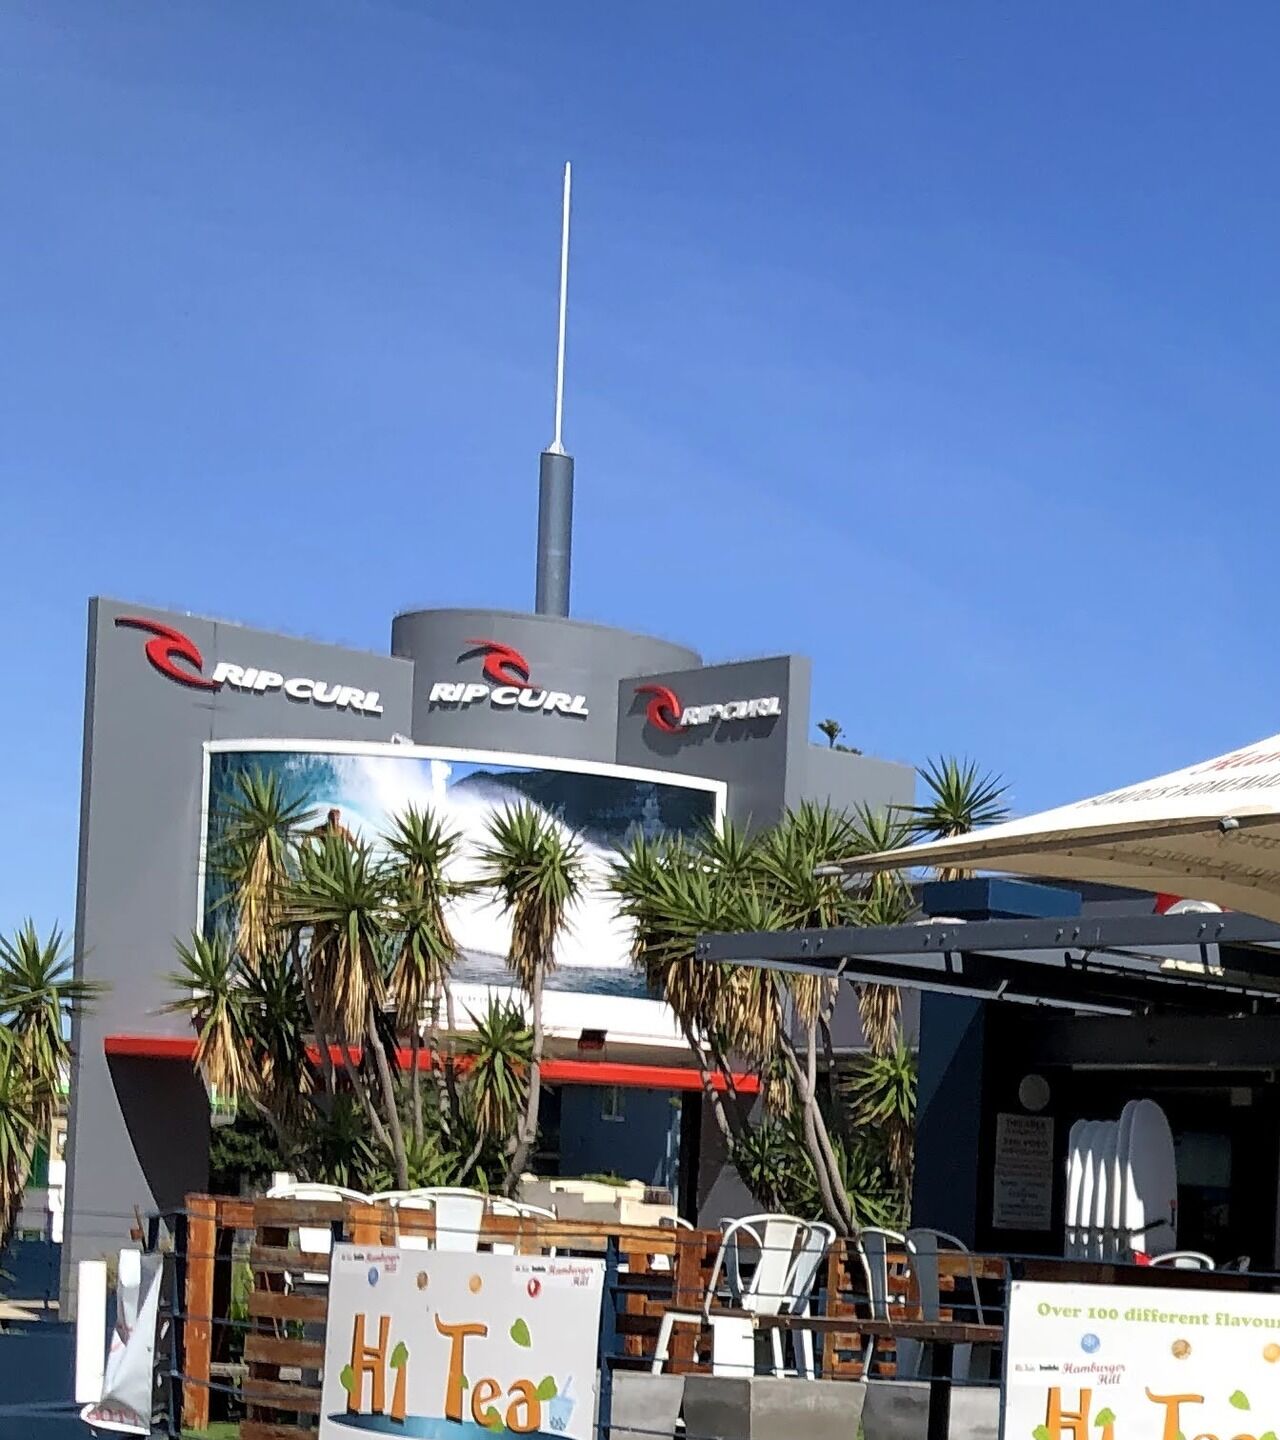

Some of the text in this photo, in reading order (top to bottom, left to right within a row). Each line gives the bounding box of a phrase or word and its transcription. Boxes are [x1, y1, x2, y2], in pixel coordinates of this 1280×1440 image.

[212, 661, 384, 713] RIP CURL
[430, 682, 589, 715] RIP CURL
[1037, 1302, 1082, 1319] Over
[1124, 1307, 1209, 1327] different
[347, 1312, 541, 1434] Hi Tea
[1060, 1361, 1127, 1376] Hamburger
[1096, 1373, 1122, 1387] Hill
